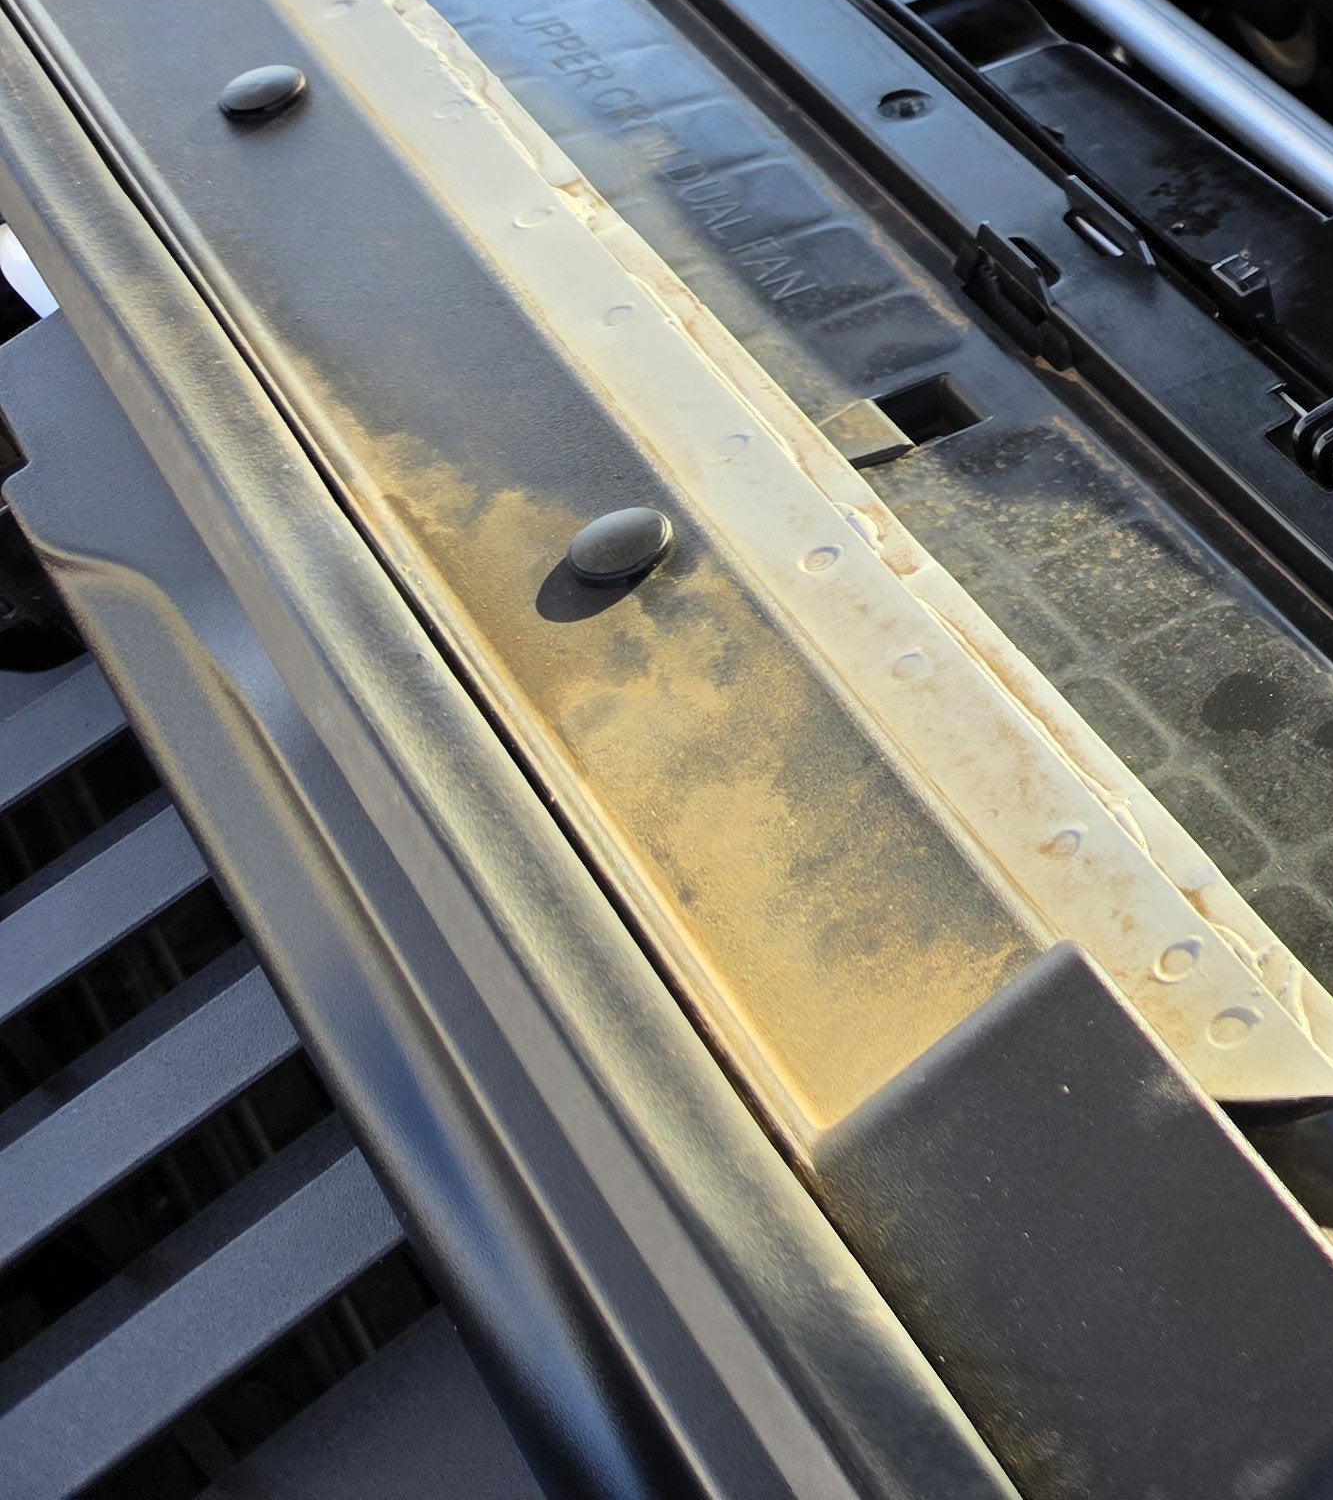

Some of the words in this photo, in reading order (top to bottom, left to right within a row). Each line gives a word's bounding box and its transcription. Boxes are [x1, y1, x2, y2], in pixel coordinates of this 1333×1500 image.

[512, 15, 615, 88] UPPER
[660, 161, 753, 241] DUAL
[730, 236, 819, 301] FAN
